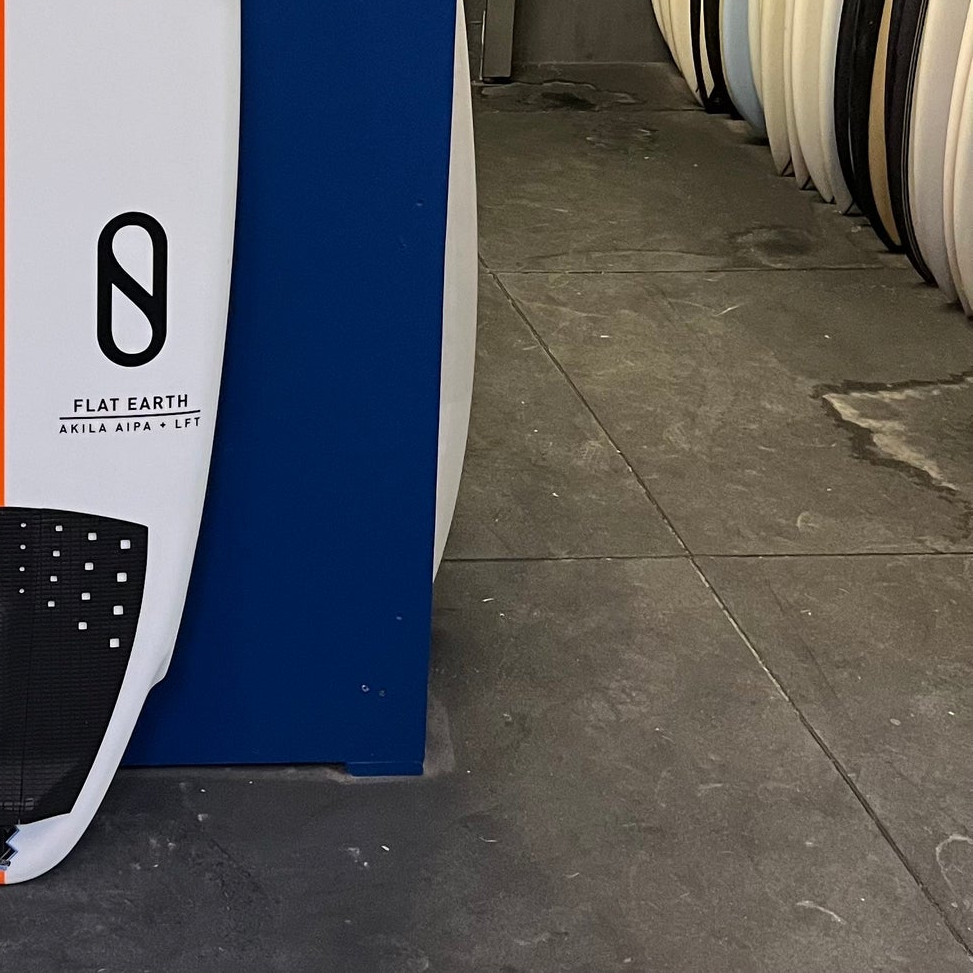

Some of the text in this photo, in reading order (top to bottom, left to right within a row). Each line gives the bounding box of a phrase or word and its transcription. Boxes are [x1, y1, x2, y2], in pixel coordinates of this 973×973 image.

[73, 393, 188, 413] FLAT EARTH
[59, 423, 107, 434] AKILA
[115, 421, 151, 433] AIPA
[175, 416, 201, 429] LFT
